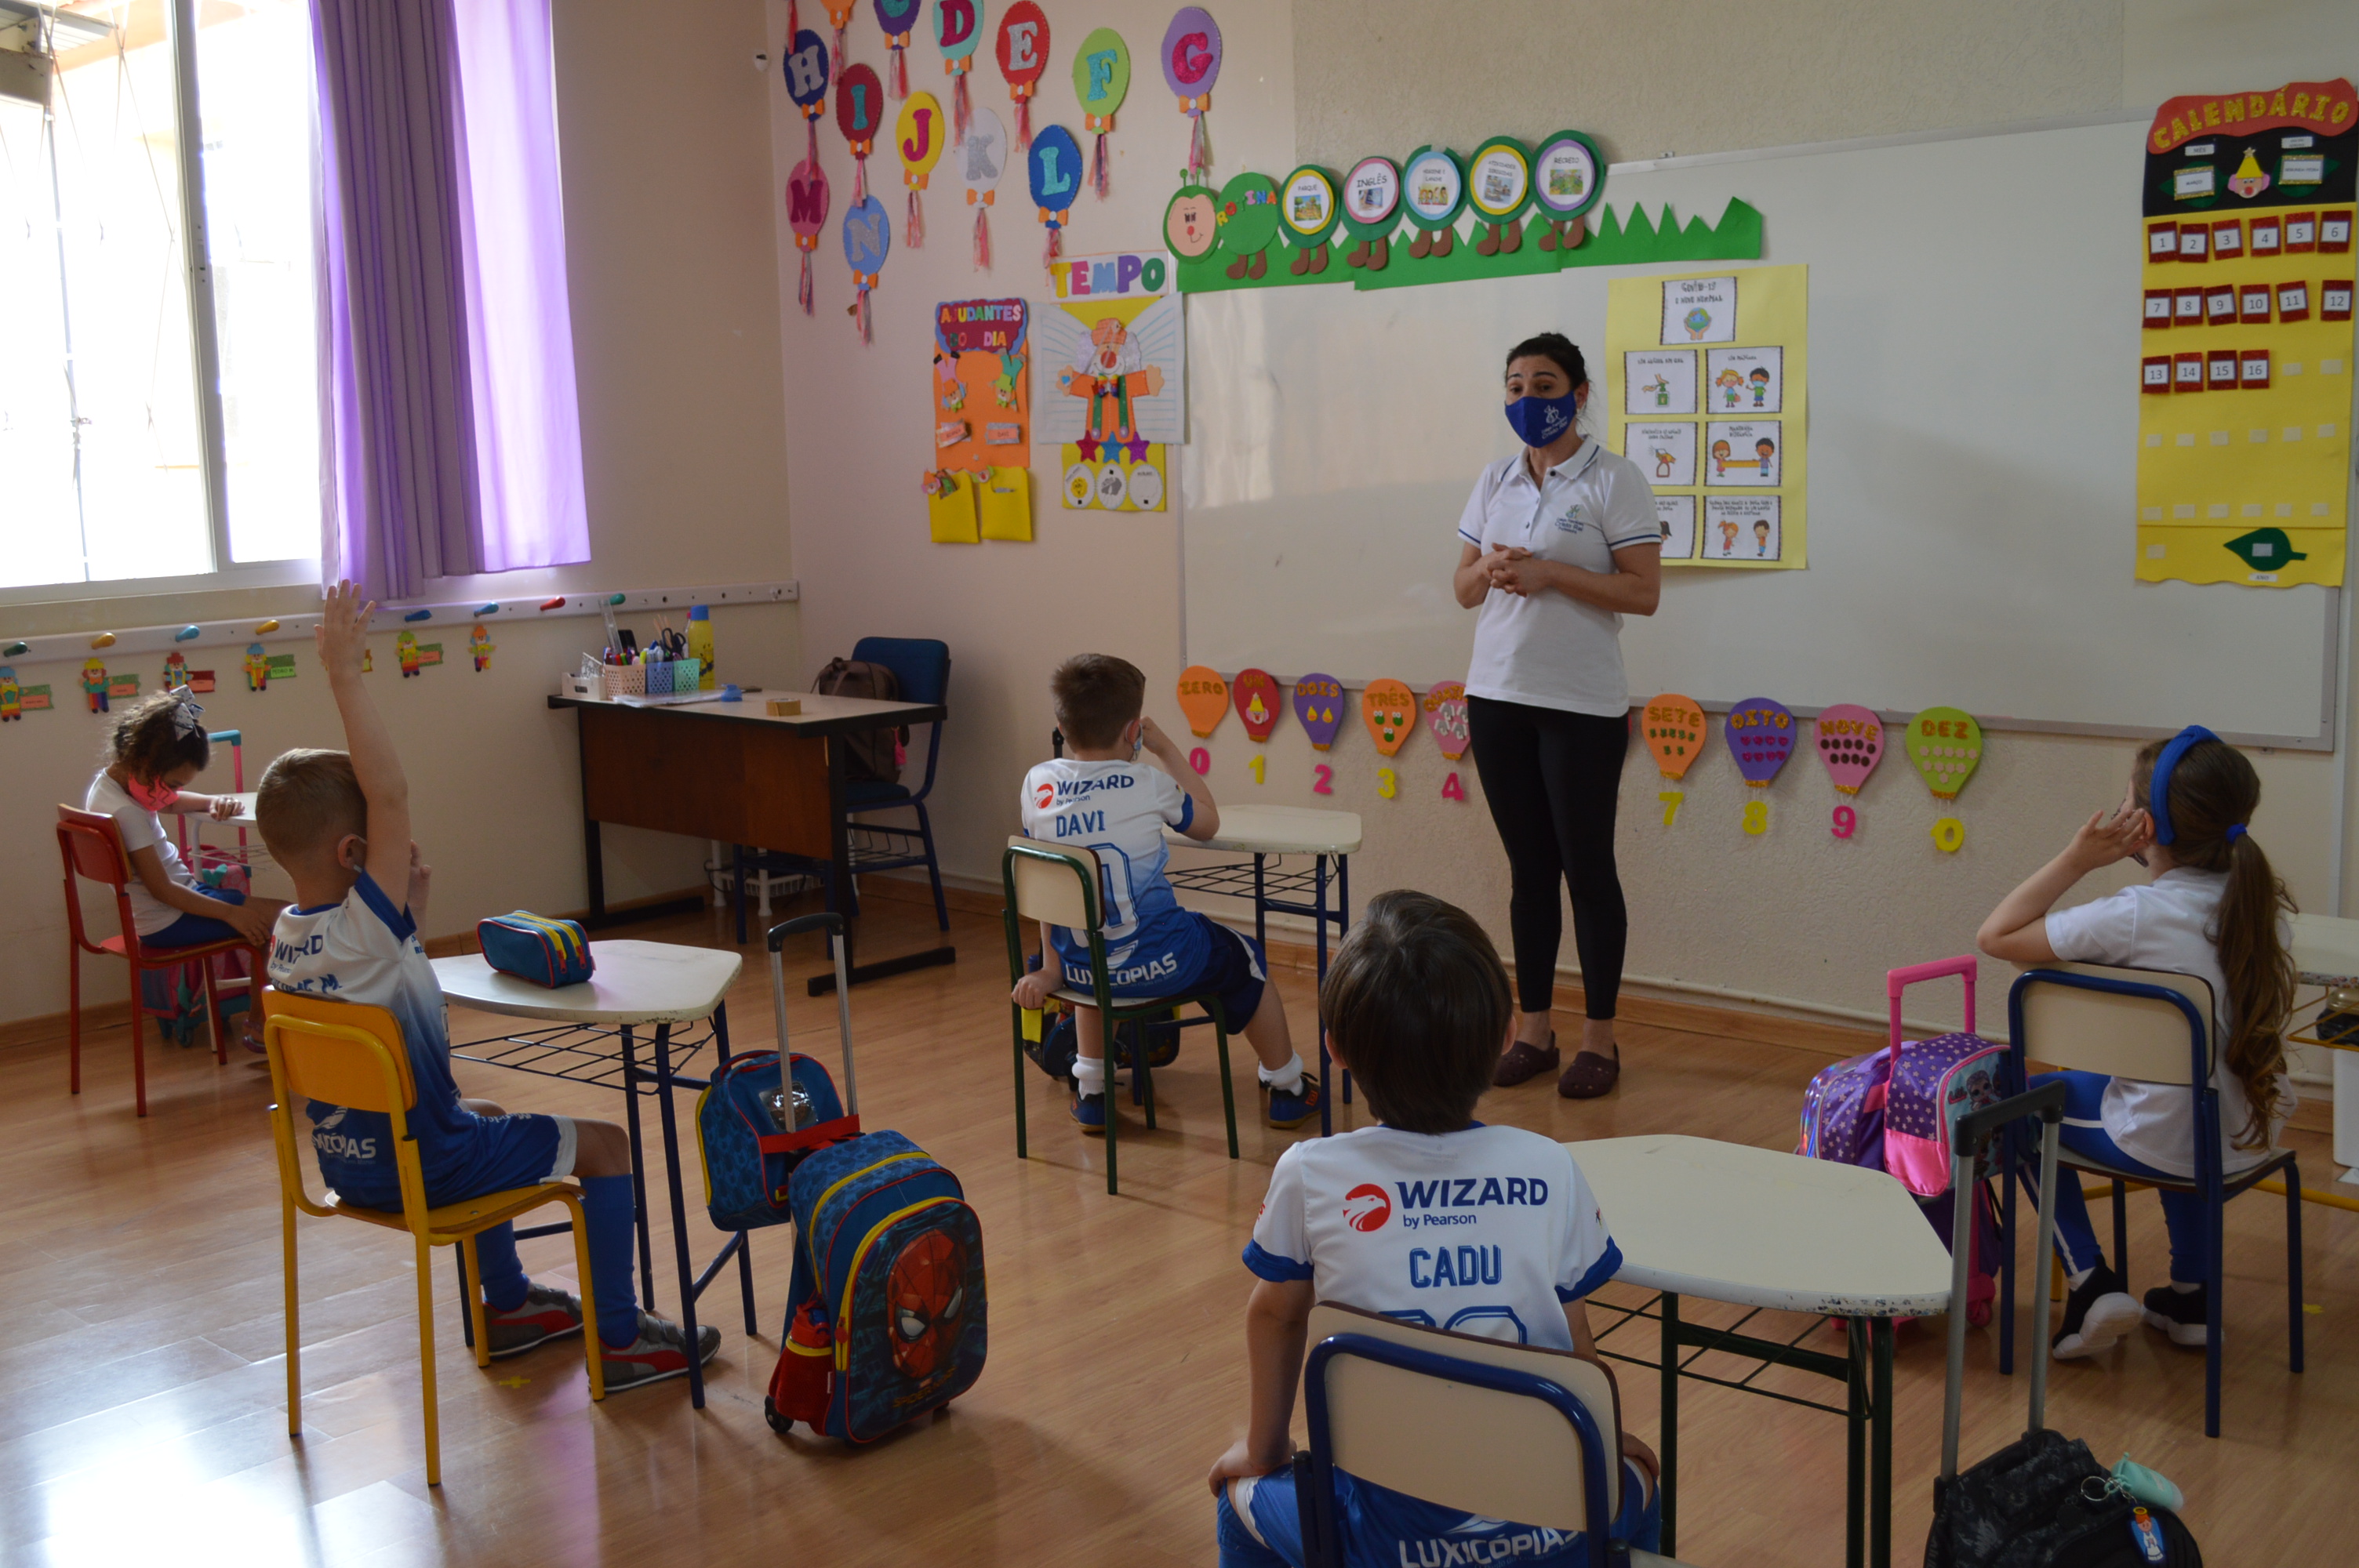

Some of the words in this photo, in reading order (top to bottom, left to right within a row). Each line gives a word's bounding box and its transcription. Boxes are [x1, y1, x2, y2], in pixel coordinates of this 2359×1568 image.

[940, 0, 975, 47] D
[1008, 21, 1038, 71] E
[1172, 32, 1213, 83] G
[788, 45, 823, 97] H
[1086, 49, 1118, 101] F
[851, 84, 868, 129] I
[2154, 83, 2349, 148] CALENDÁRIO
[903, 108, 932, 162] J
[966, 134, 998, 180] K
[1041, 147, 1070, 195] L
[1357, 172, 1387, 187] INGLÊS
[791, 179, 823, 224] M
[847, 213, 881, 262] N
[2160, 238, 2165, 248] 1
[2190, 240, 2196, 249] 2
[2223, 236, 2230, 245] 3
[2261, 234, 2269, 244] 4
[2296, 229, 2303, 238] 5
[2332, 227, 2339, 238] 6
[1050, 255, 1165, 298] TEMPO
[941, 304, 1022, 323] AJUDANTES
[2154, 303, 2161, 313] 7
[2185, 301, 2192, 310] 8
[2216, 300, 2223, 310] 9
[2249, 299, 2263, 309] 10
[2285, 296, 2299, 307] 11
[2330, 296, 2344, 307] 12
[950, 332, 967, 347] DO
[983, 331, 1007, 347] DIA
[2150, 370, 2162, 379] 13
[2183, 367, 2195, 377] 14
[2215, 365, 2229, 376] 15
[2248, 365, 2262, 376] 16
[1180, 681, 1224, 696] ZERO
[1297, 678, 1339, 697] DOIS
[1366, 687, 1409, 708] TRÊS
[1648, 706, 1701, 728] SETE
[1731, 710, 1789, 729] OITO
[1819, 719, 1879, 742] NOVE
[1921, 719, 1969, 739] DEZ
[1189, 747, 1210, 775] 0
[1249, 755, 1265, 784] 1
[1056, 775, 1134, 796] WIZARD
[1314, 764, 1332, 794] 2
[1376, 768, 1396, 799] 3
[1441, 772, 1464, 800] 4
[1056, 797, 1064, 807] by
[1659, 792, 1684, 826] 7
[1056, 809, 1106, 837] DAVI
[1742, 800, 1768, 835] 8
[1830, 804, 1856, 839] 9
[1394, 1177, 1548, 1210] WIZARD
[1403, 1214, 1419, 1229] by
[1423, 1212, 1477, 1227] Pearson
[1409, 1243, 1502, 1289] CADU
